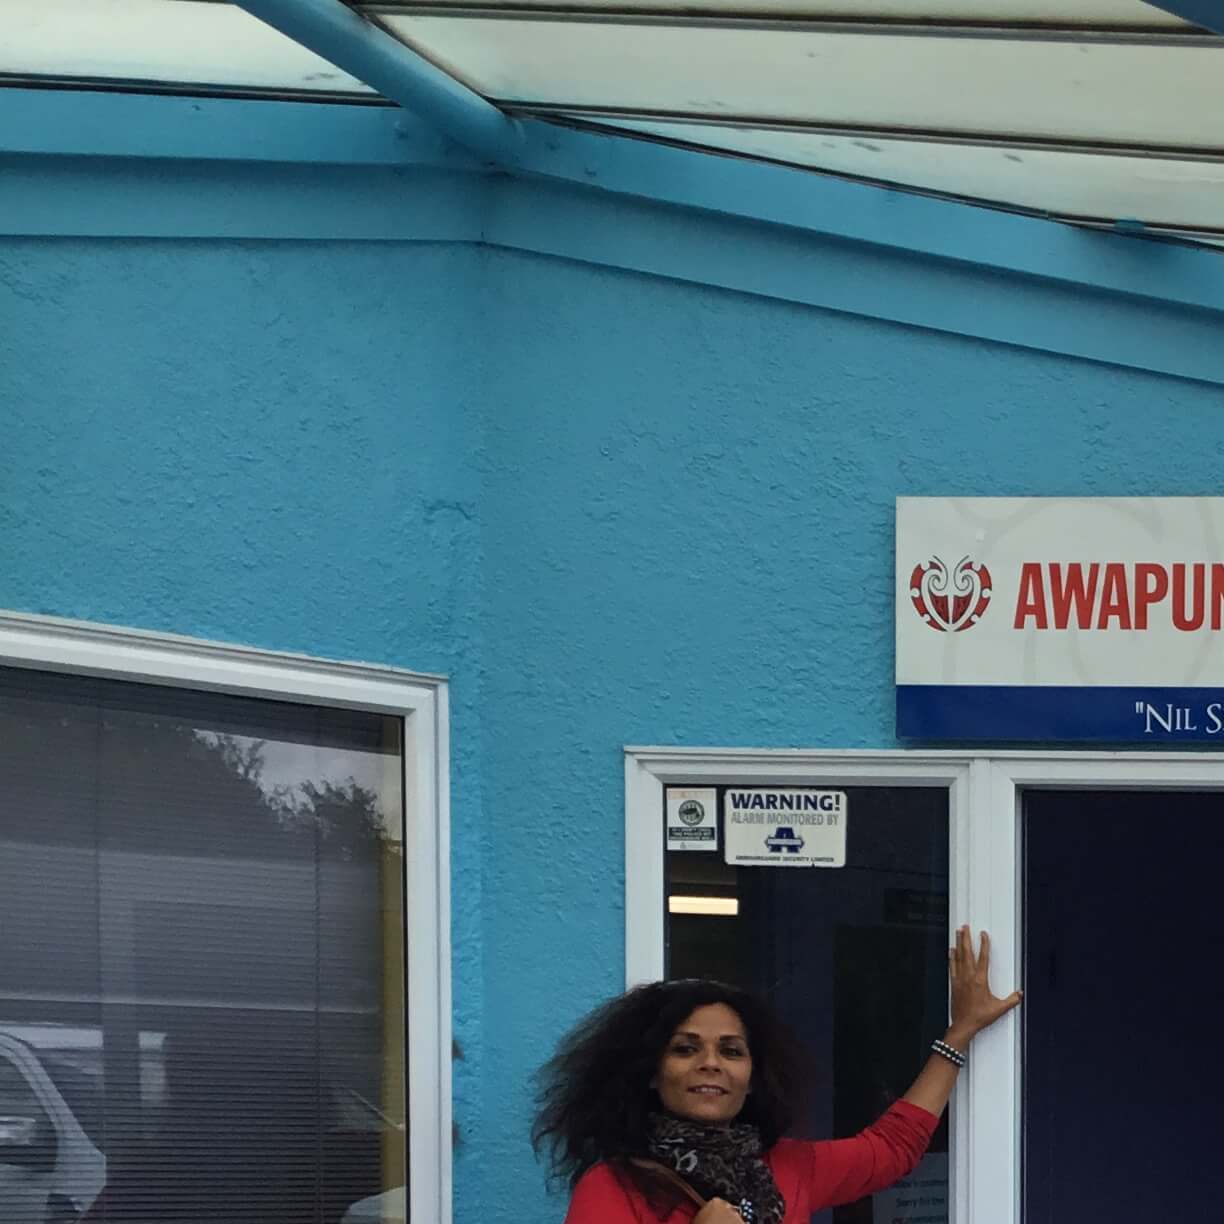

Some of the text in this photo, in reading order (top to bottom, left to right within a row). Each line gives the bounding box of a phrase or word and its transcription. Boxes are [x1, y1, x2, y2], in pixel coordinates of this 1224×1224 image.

[730, 793, 841, 812] WARNING!
[730, 812, 839, 826] ALARM MONITORED BY
